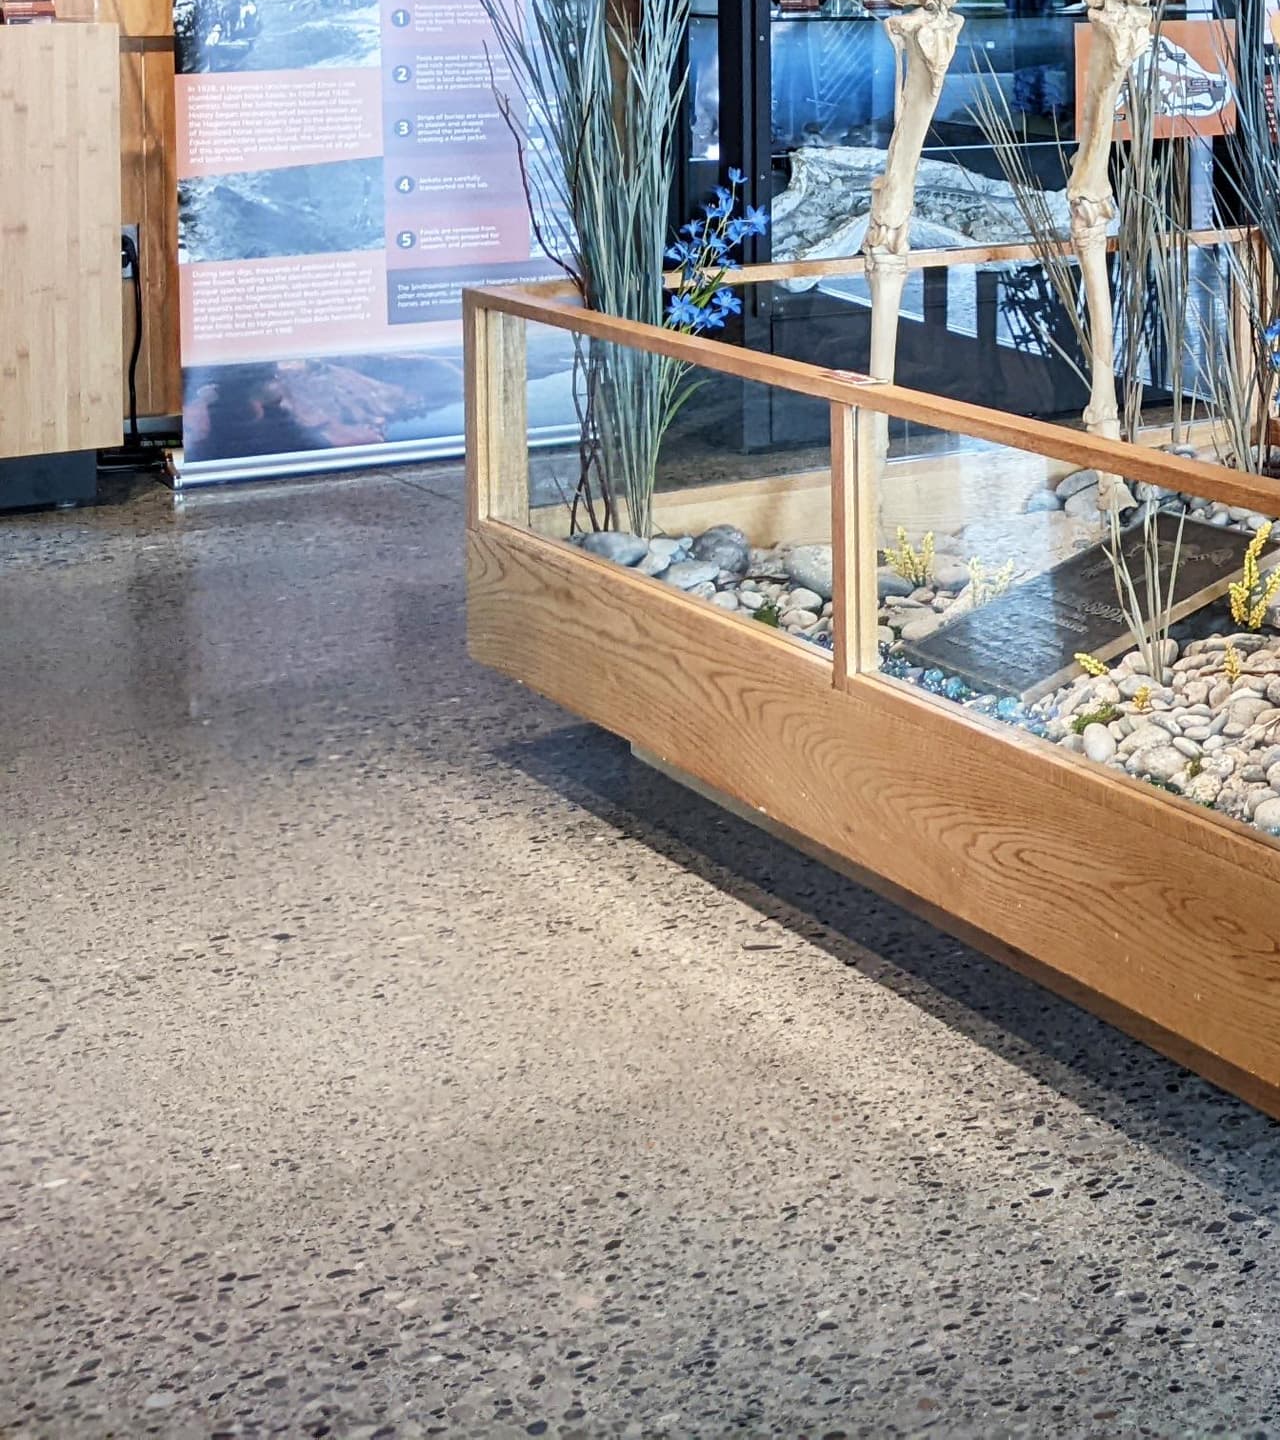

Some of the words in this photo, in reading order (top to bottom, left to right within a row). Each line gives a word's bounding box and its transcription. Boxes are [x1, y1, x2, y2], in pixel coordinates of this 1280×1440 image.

[396, 12, 404, 24] 1
[397, 68, 407, 80] 2
[399, 123, 408, 135] 3
[400, 179, 409, 191] 4
[402, 233, 411, 246] 5
